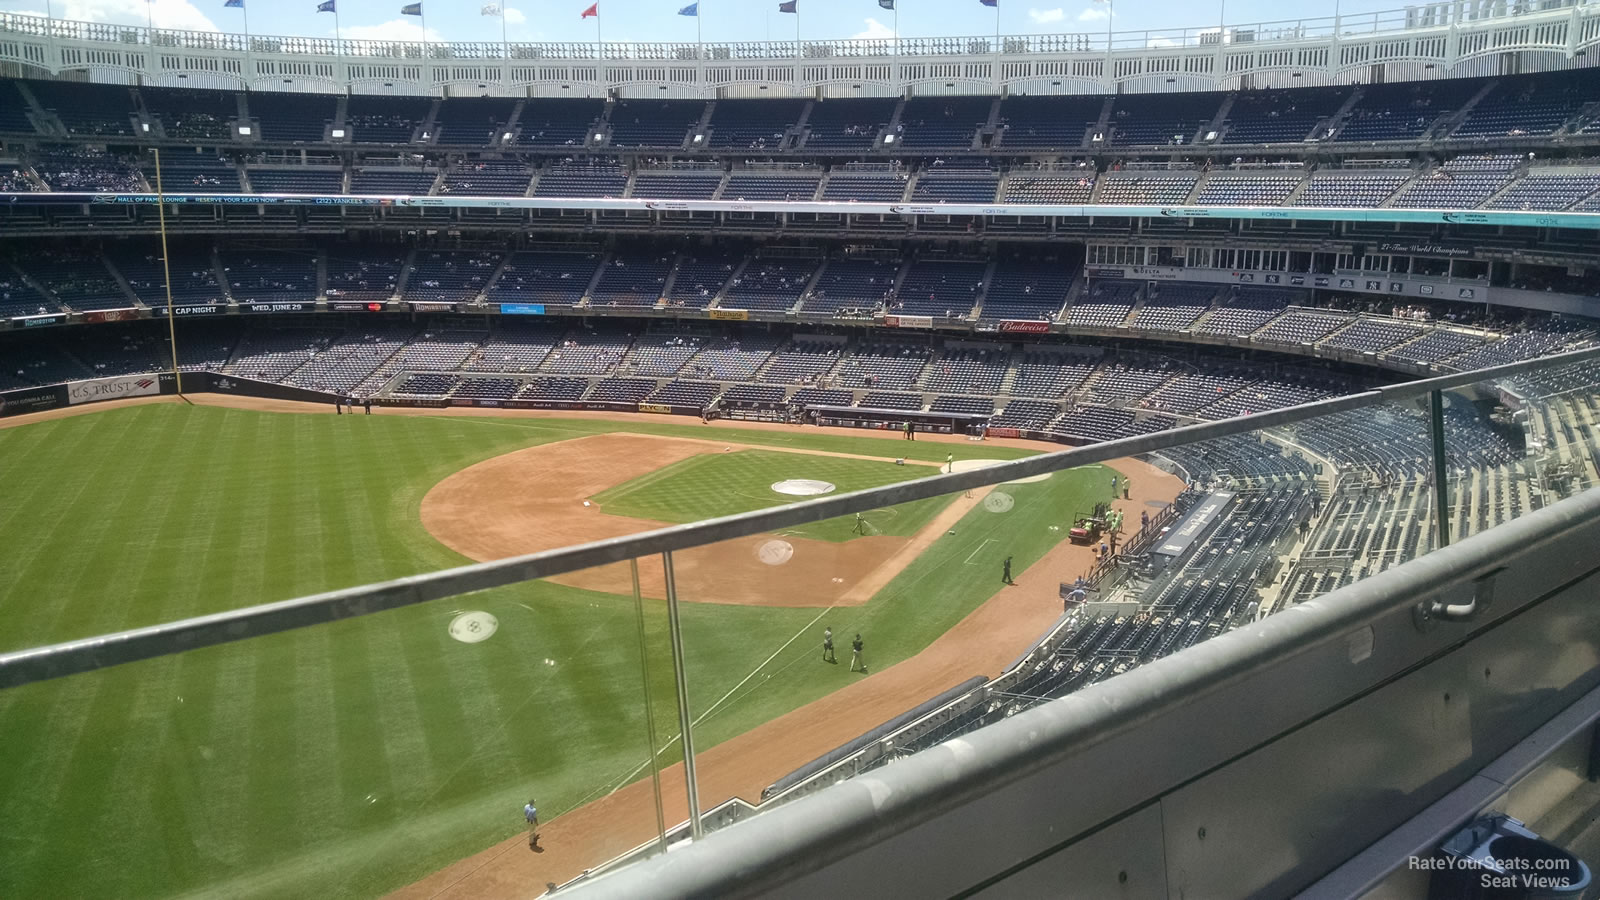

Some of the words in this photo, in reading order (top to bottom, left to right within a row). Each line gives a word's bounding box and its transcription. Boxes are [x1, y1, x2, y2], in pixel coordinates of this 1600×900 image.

[1410, 245, 1432, 253] World
[1433, 246, 1469, 256] Champions
[175, 307, 191, 315] CAP
[192, 306, 217, 314] NIGHT
[1002, 321, 1049, 332] Budweiser
[72, 386, 92, 398] U.S.
[93, 382, 131, 394] TRUST
